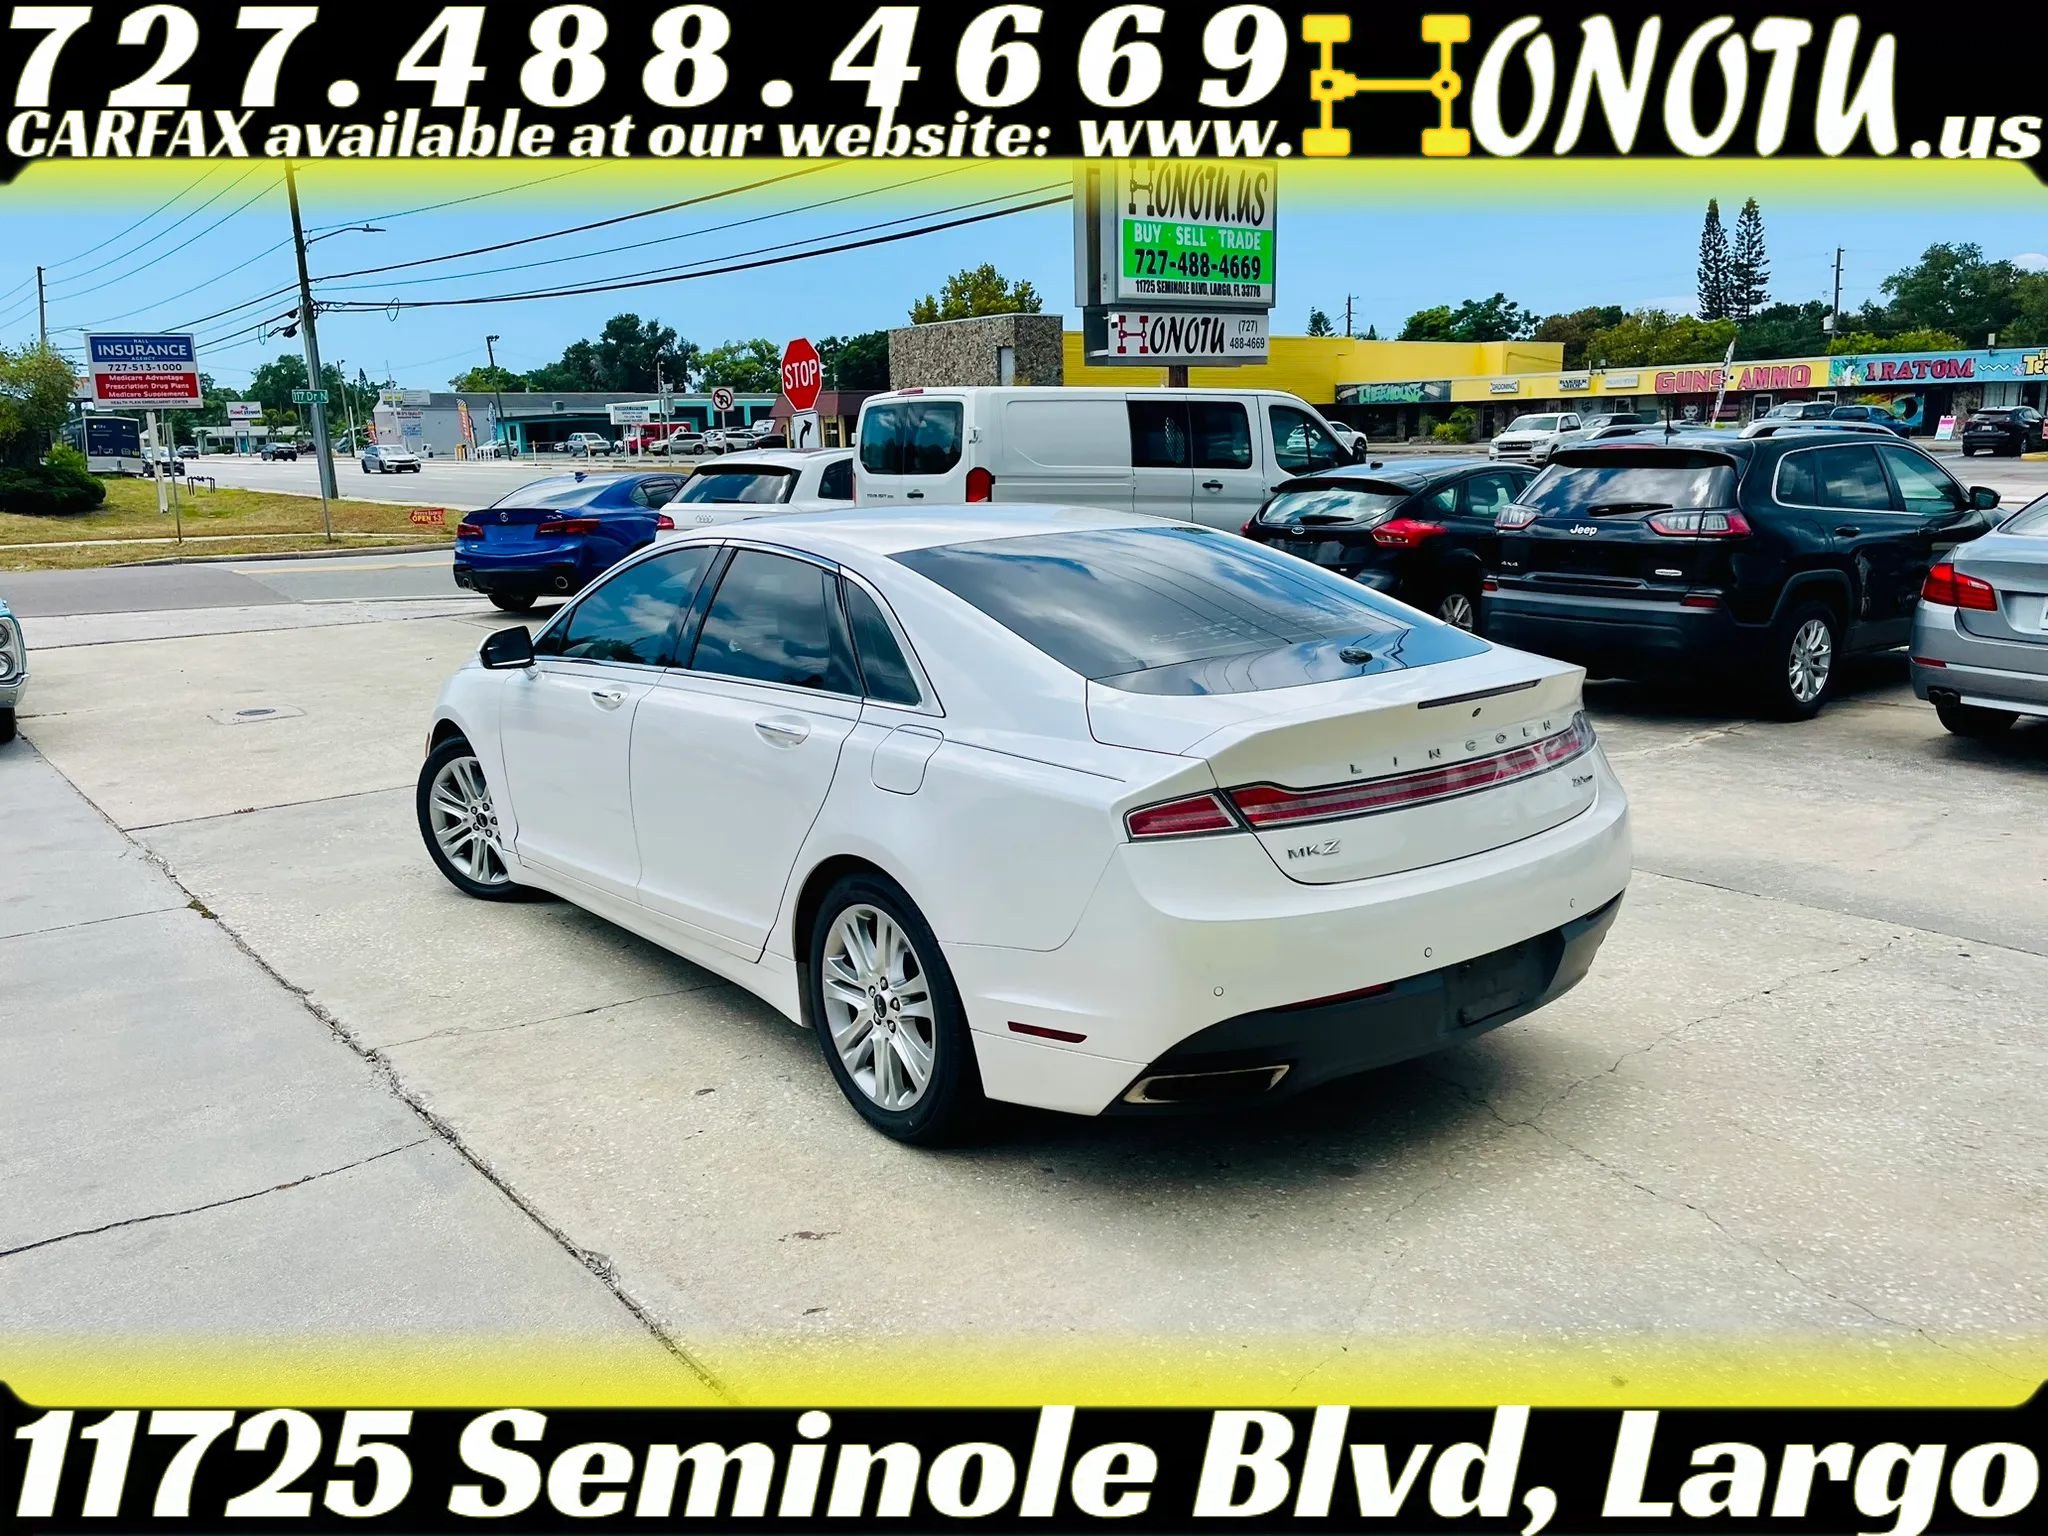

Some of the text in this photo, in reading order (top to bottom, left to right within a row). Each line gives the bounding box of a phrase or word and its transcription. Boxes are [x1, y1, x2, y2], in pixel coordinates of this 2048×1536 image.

[1134, 223, 1261, 250] BUY SELL TRADE
[1134, 248, 1261, 280] 727-488-4669
[1136, 280, 1261, 298] 11725 SEMINOLE BLVD, LARGO, FL 33778
[1117, 314, 1225, 354] HONOTU
[1238, 320, 1258, 333] (727)
[97, 344, 188, 356] INSURANCE
[1229, 337, 1265, 349] 488-4669
[107, 363, 182, 372] 727-513-1000
[784, 358, 818, 390] STOP
[145, 374, 184, 382] Advantage
[1655, 364, 1811, 394] GUNS AMMO
[143, 390, 189, 398] Supplements
[293, 392, 328, 401] 117 Dr N
[1570, 524, 1598, 537] Jeep
[1350, 719, 1552, 775] LINCOLN
[1287, 838, 1342, 860] MKZ
